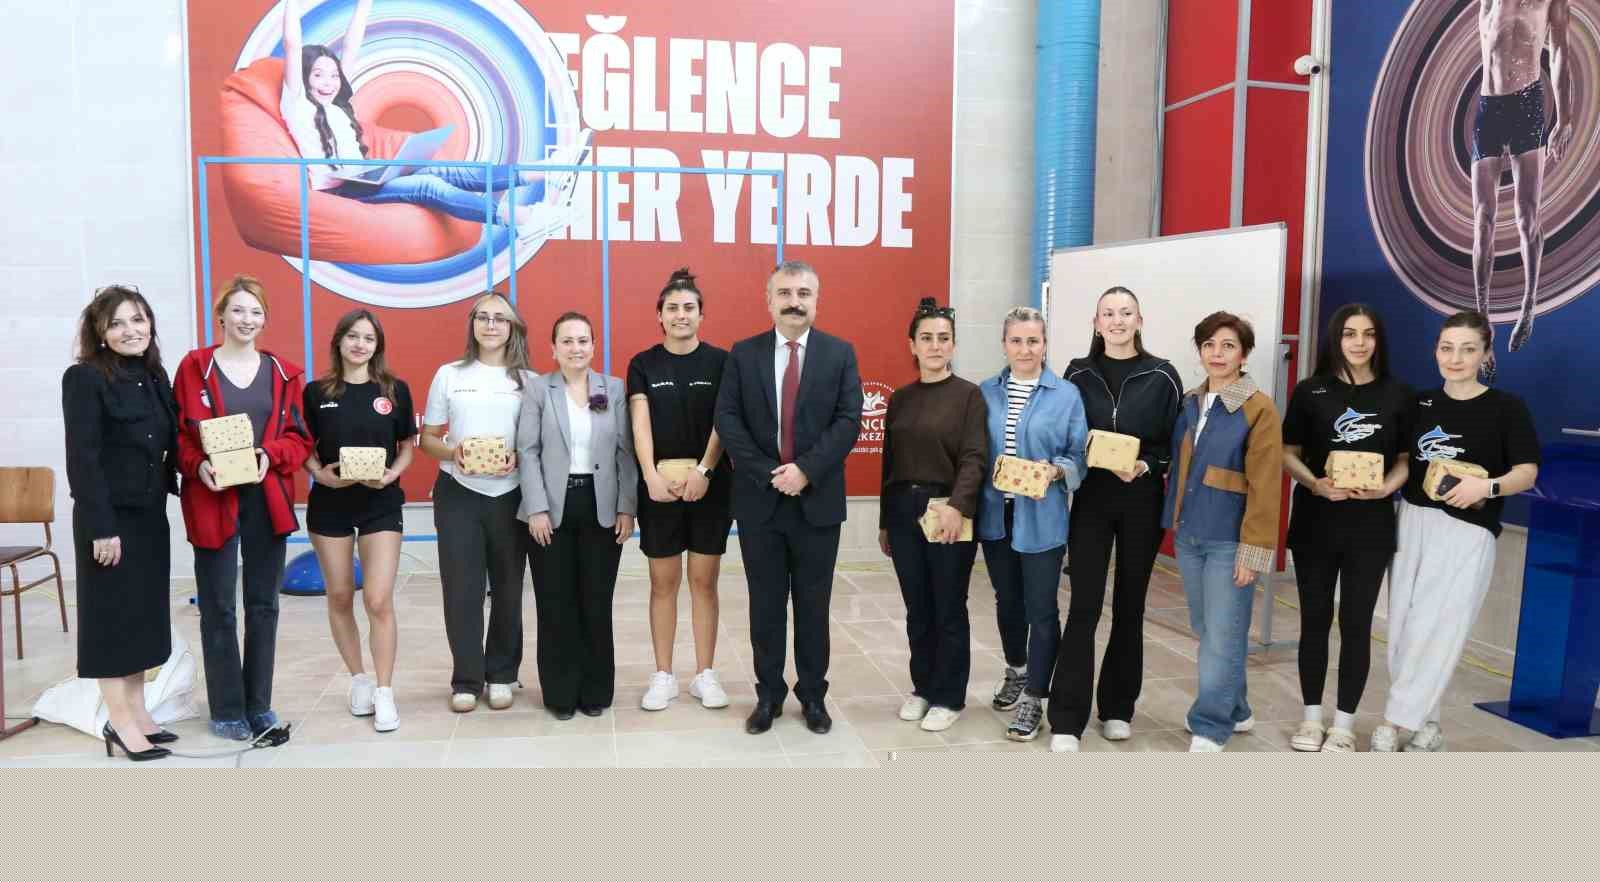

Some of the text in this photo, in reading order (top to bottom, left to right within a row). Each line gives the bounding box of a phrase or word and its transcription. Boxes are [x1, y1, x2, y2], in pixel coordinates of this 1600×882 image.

[544, 14, 842, 138] EĞLENCE
[544, 145, 914, 248] HER YERDE
